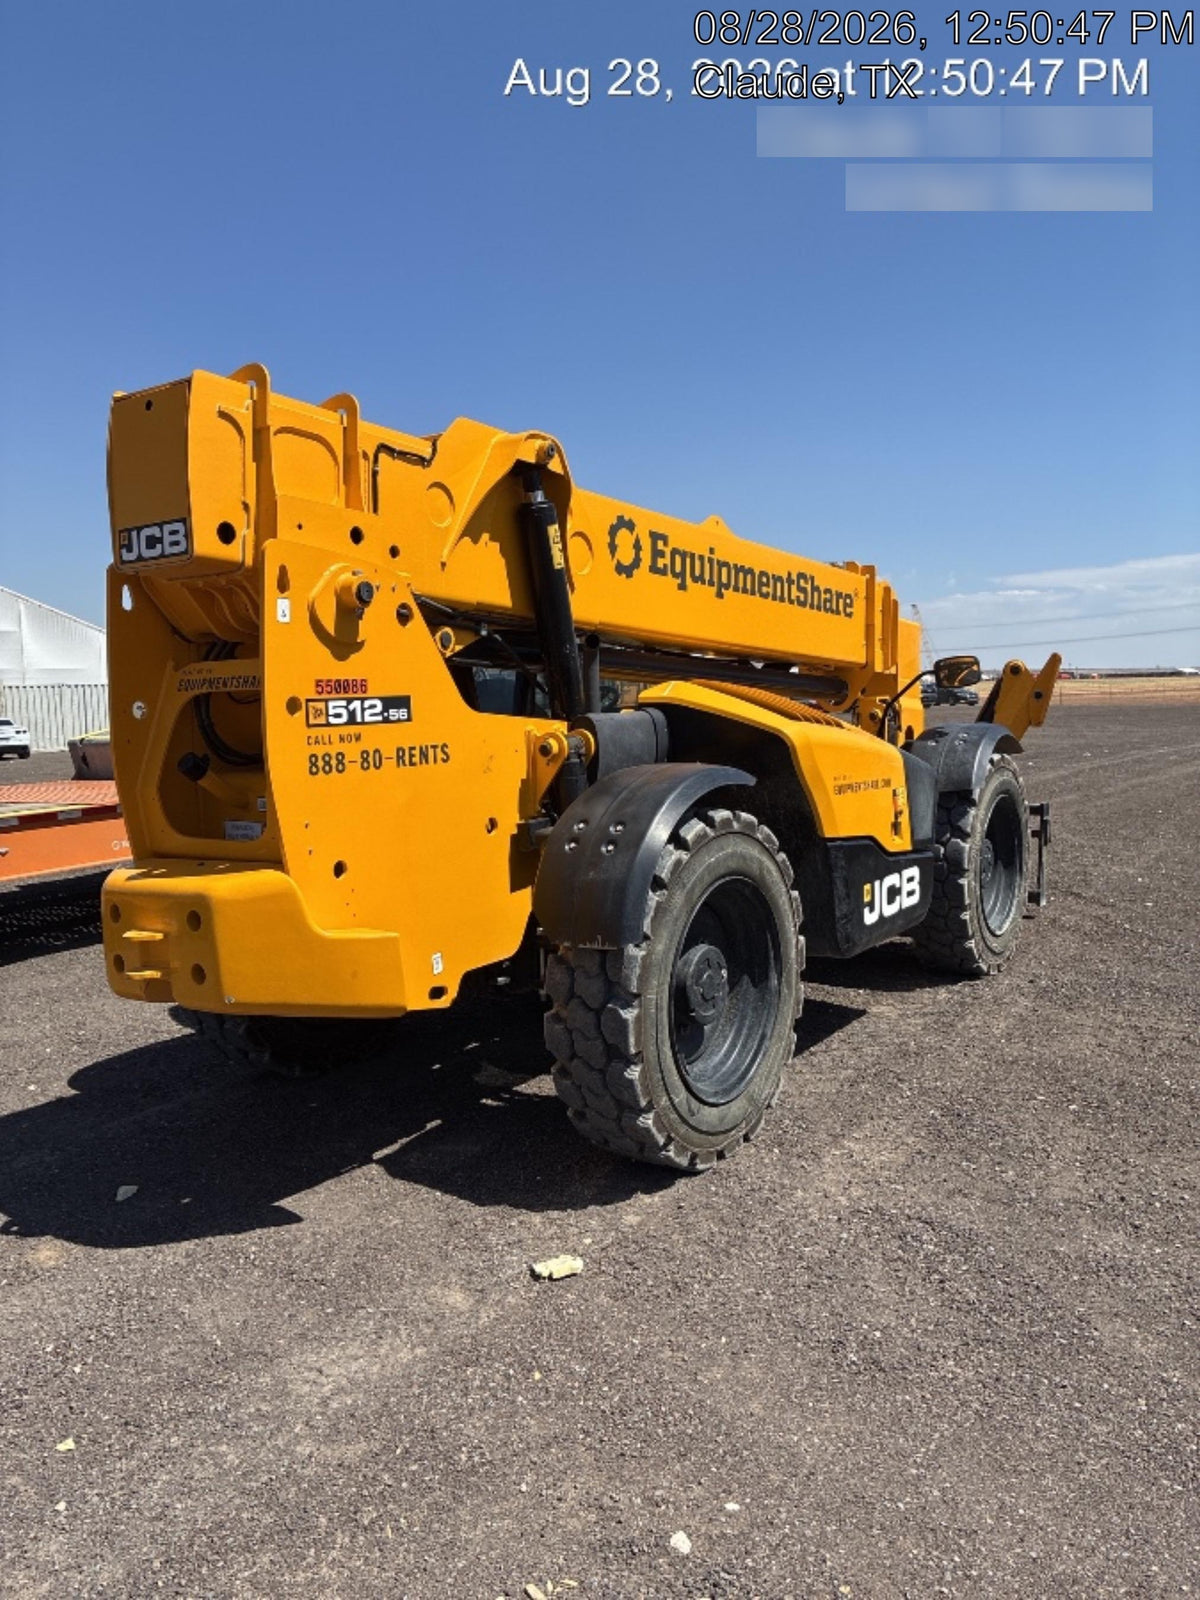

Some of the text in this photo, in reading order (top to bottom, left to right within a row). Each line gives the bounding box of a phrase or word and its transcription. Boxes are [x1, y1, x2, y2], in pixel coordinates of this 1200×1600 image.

[120, 522, 187, 561] JCB
[648, 529, 855, 619] EquipmentShare
[315, 678, 368, 695] 550086
[306, 732, 362, 746] CALL NOW
[308, 743, 450, 776] 888-80-RENTS
[863, 865, 920, 925] JCB
